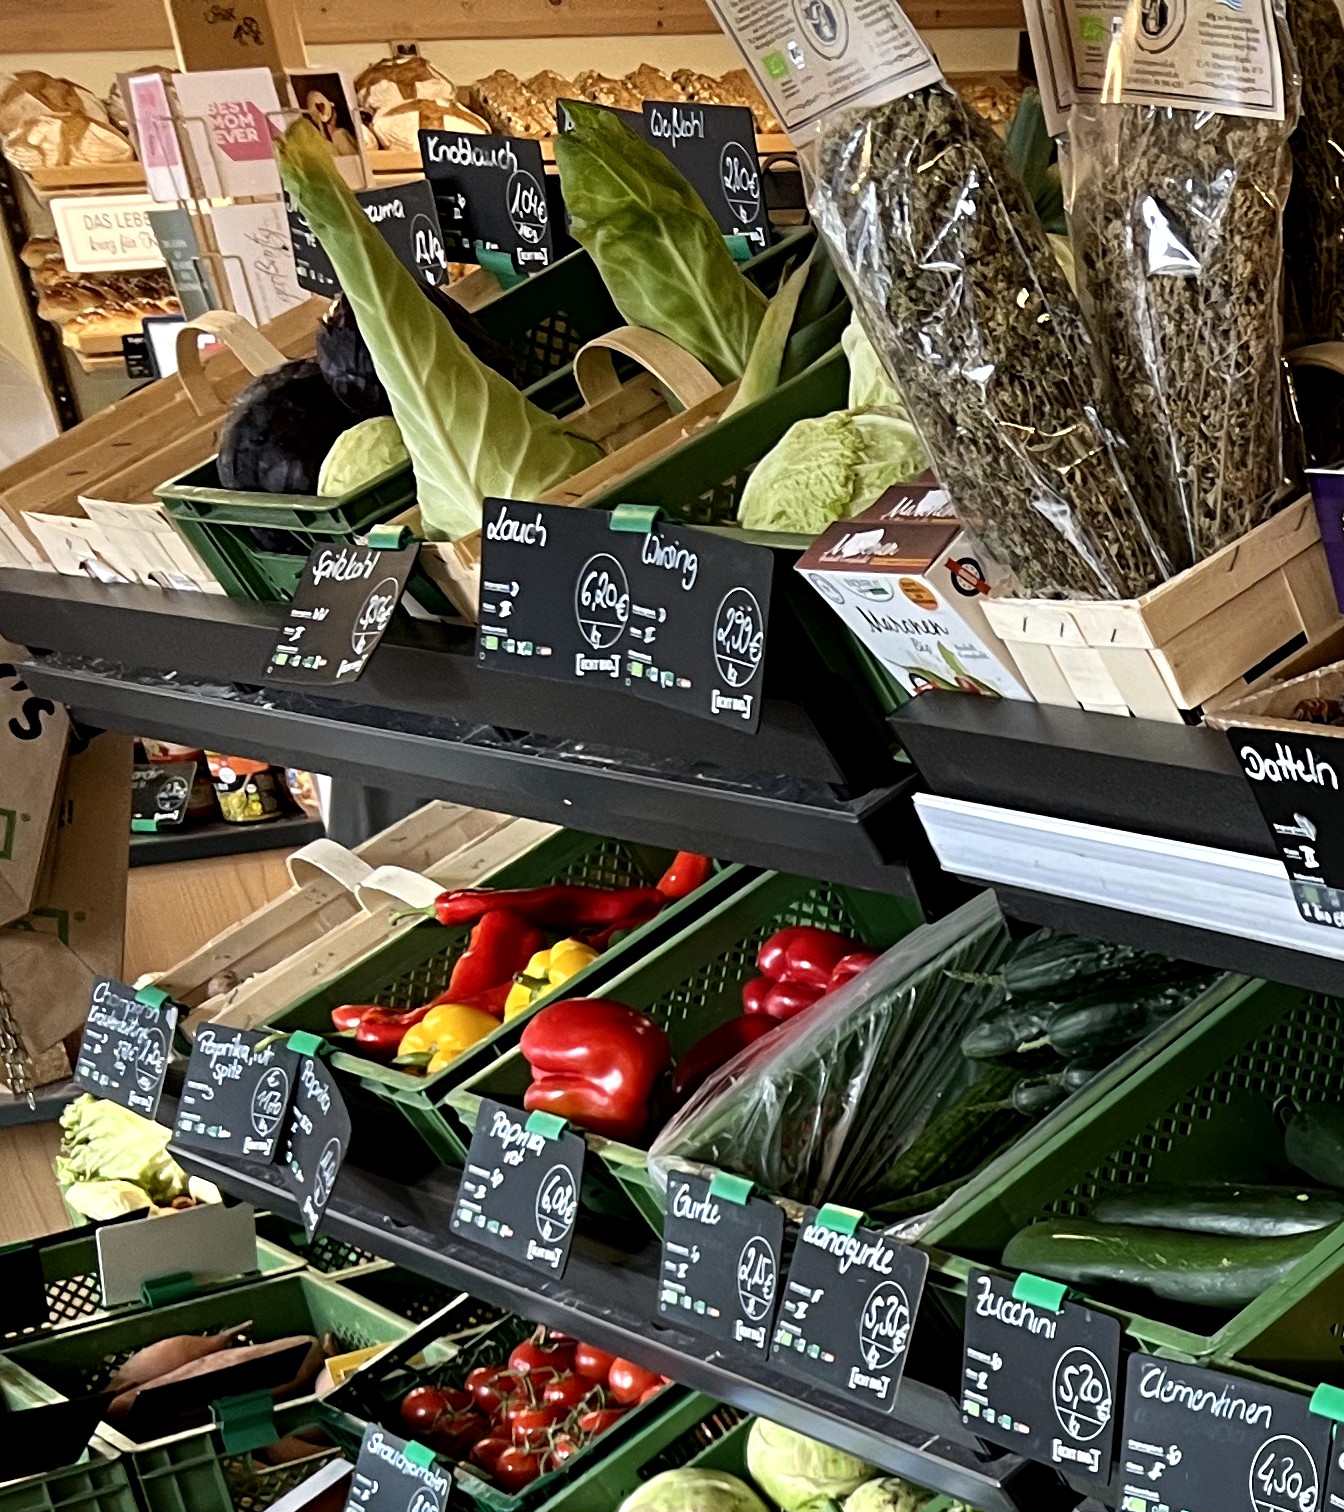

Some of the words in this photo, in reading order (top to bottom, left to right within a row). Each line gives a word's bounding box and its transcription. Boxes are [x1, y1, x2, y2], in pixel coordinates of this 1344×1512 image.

[211, 114, 255, 129] MOM
[215, 127, 260, 145] EVER
[1241, 742, 1339, 790] Datteln
[673, 1181, 723, 1226] Gurke
[1139, 1367, 1274, 1429] Clementinen
